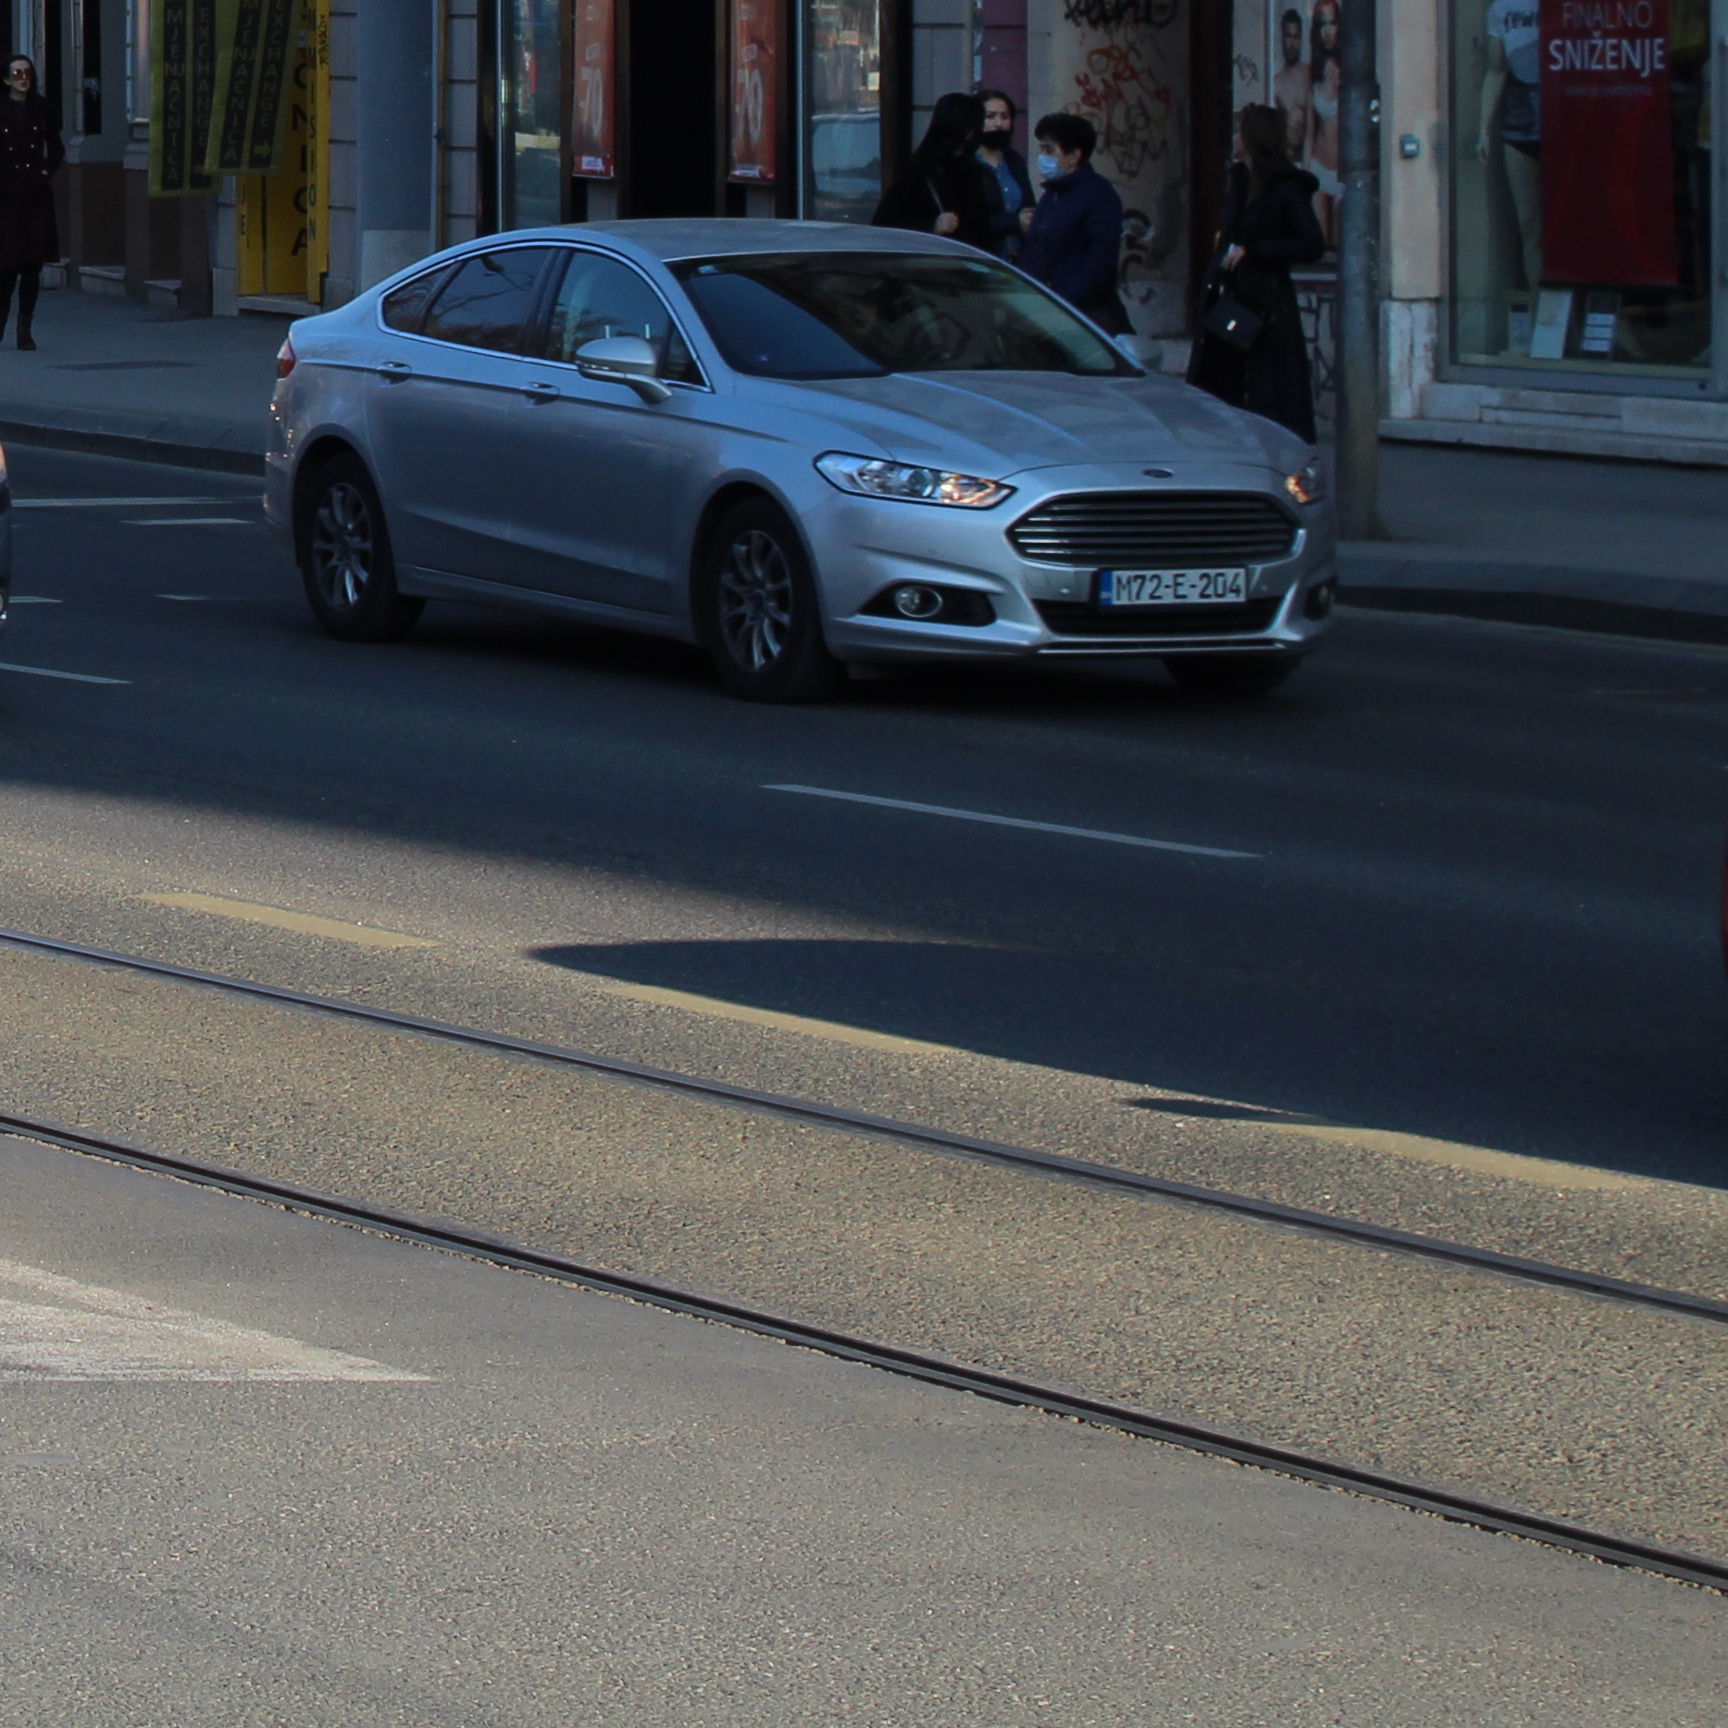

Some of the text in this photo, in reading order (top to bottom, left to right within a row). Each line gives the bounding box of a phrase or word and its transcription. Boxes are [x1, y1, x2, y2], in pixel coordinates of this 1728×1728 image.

[1562, 0, 1654, 29] FINALNO
[1548, 29, 1666, 79] SNIŽENJE
[1115, 572, 1242, 602] M72-E-204
